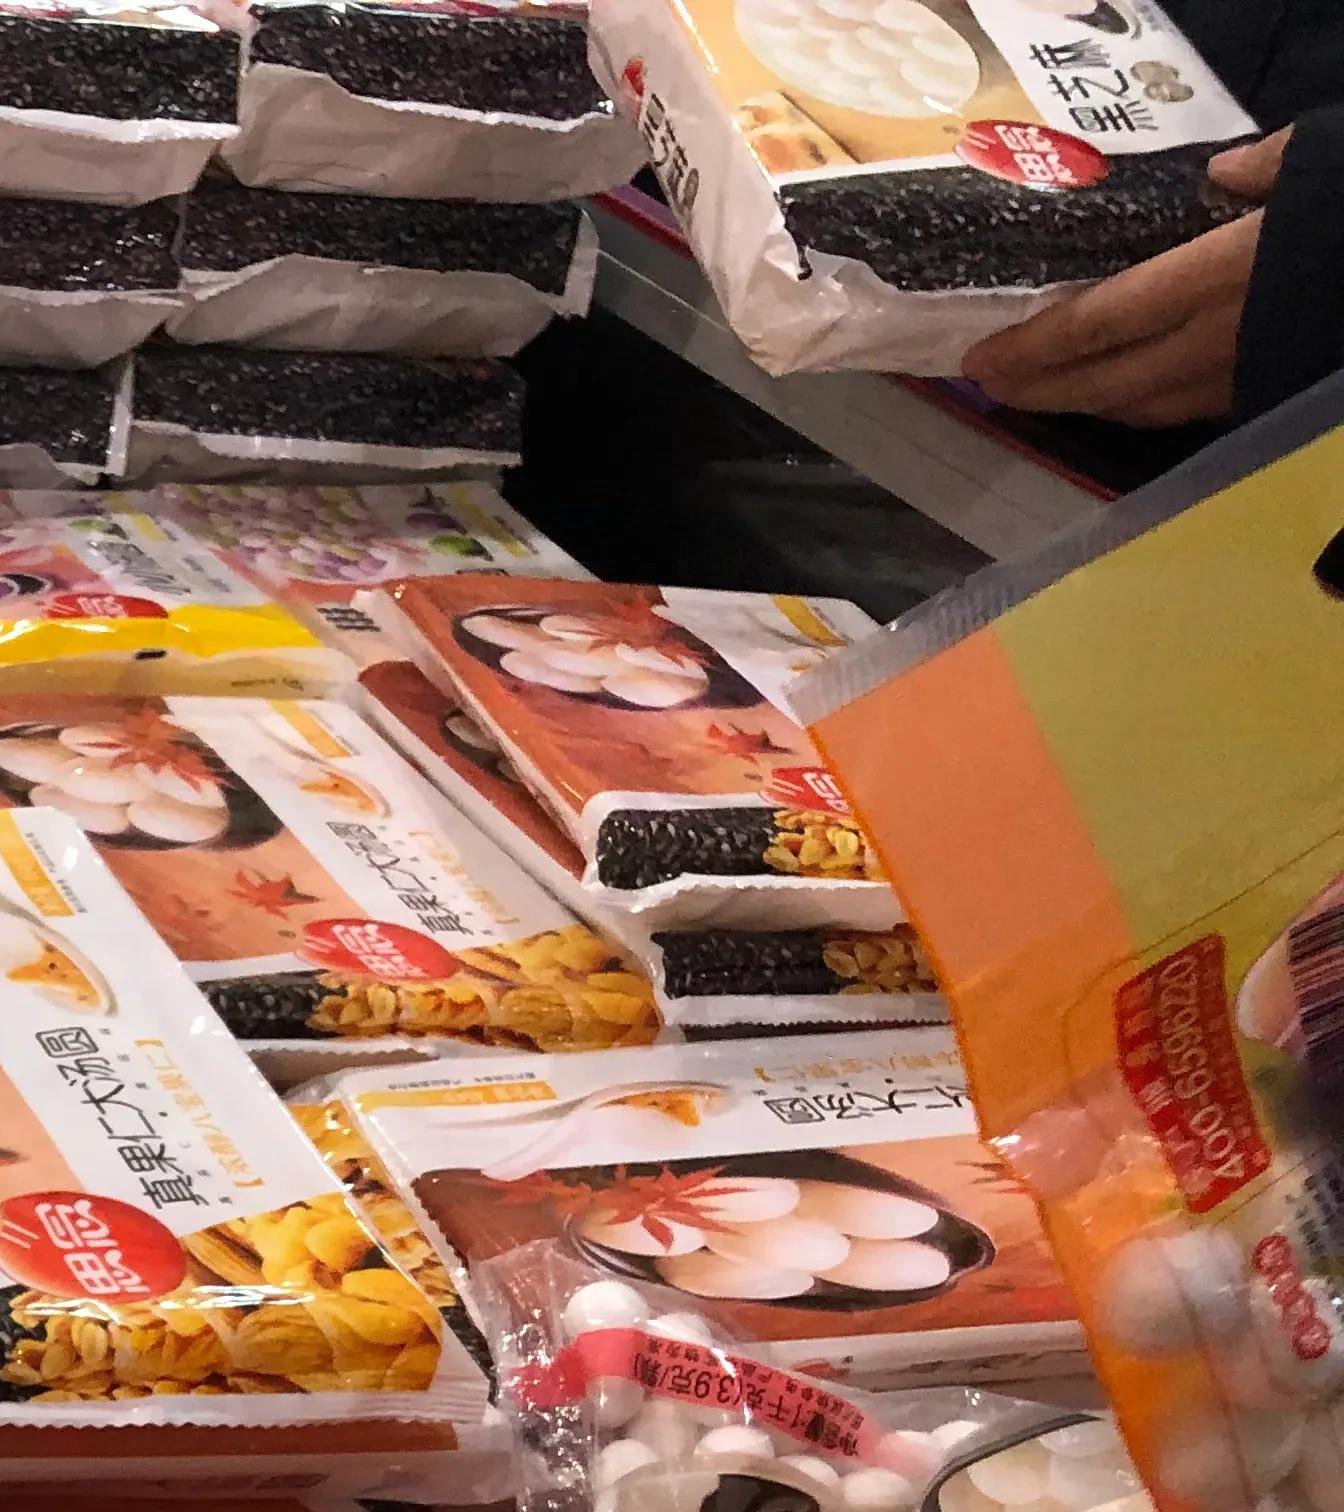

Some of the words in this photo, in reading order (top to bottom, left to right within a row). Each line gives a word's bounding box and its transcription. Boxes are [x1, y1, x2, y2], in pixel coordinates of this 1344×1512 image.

[1029, 38, 1159, 135] 黑芝麻
[996, 122, 1080, 185] 思念
[34, 1025, 211, 1209] 真果仁大汤圆
[33, 1199, 152, 1299] 思念
